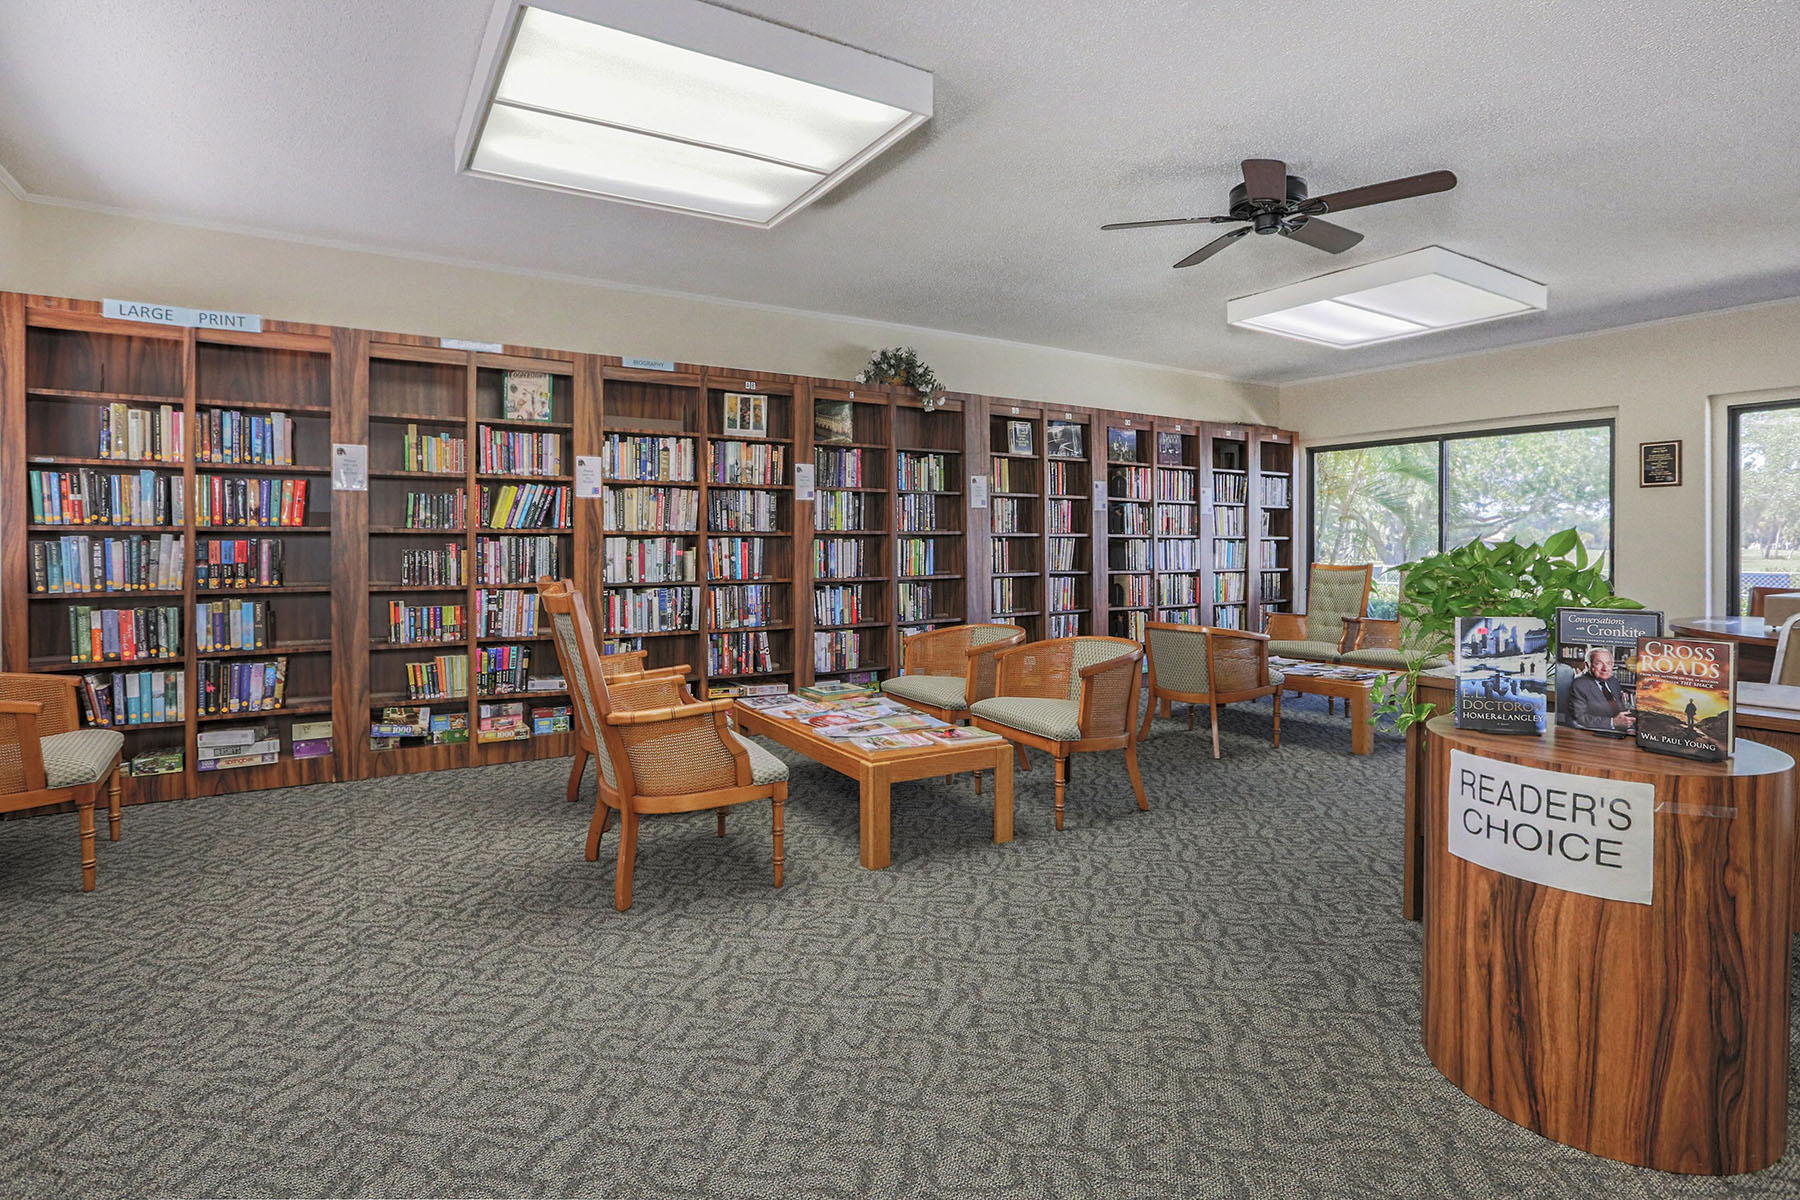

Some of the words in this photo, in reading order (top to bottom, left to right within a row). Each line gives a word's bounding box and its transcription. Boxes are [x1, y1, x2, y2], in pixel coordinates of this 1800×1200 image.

[119, 304, 174, 321] LARGE
[199, 313, 246, 328] PRINT
[633, 360, 665, 368] BIOGRAPHY
[1568, 614, 1625, 626] Conversations
[1587, 623, 1646, 639] Cronkite
[1645, 641, 1716, 662] CROSS
[1639, 654, 1720, 679] ROADS
[1463, 688, 1486, 698] E.L.
[392, 725, 411, 734] 1000
[1640, 732, 1659, 742] WM.
[1662, 736, 1683, 746] PAUL
[1684, 739, 1716, 751] YOUNG
[1461, 768, 1632, 832] READER'S
[1463, 808, 1624, 869] CHOICE
